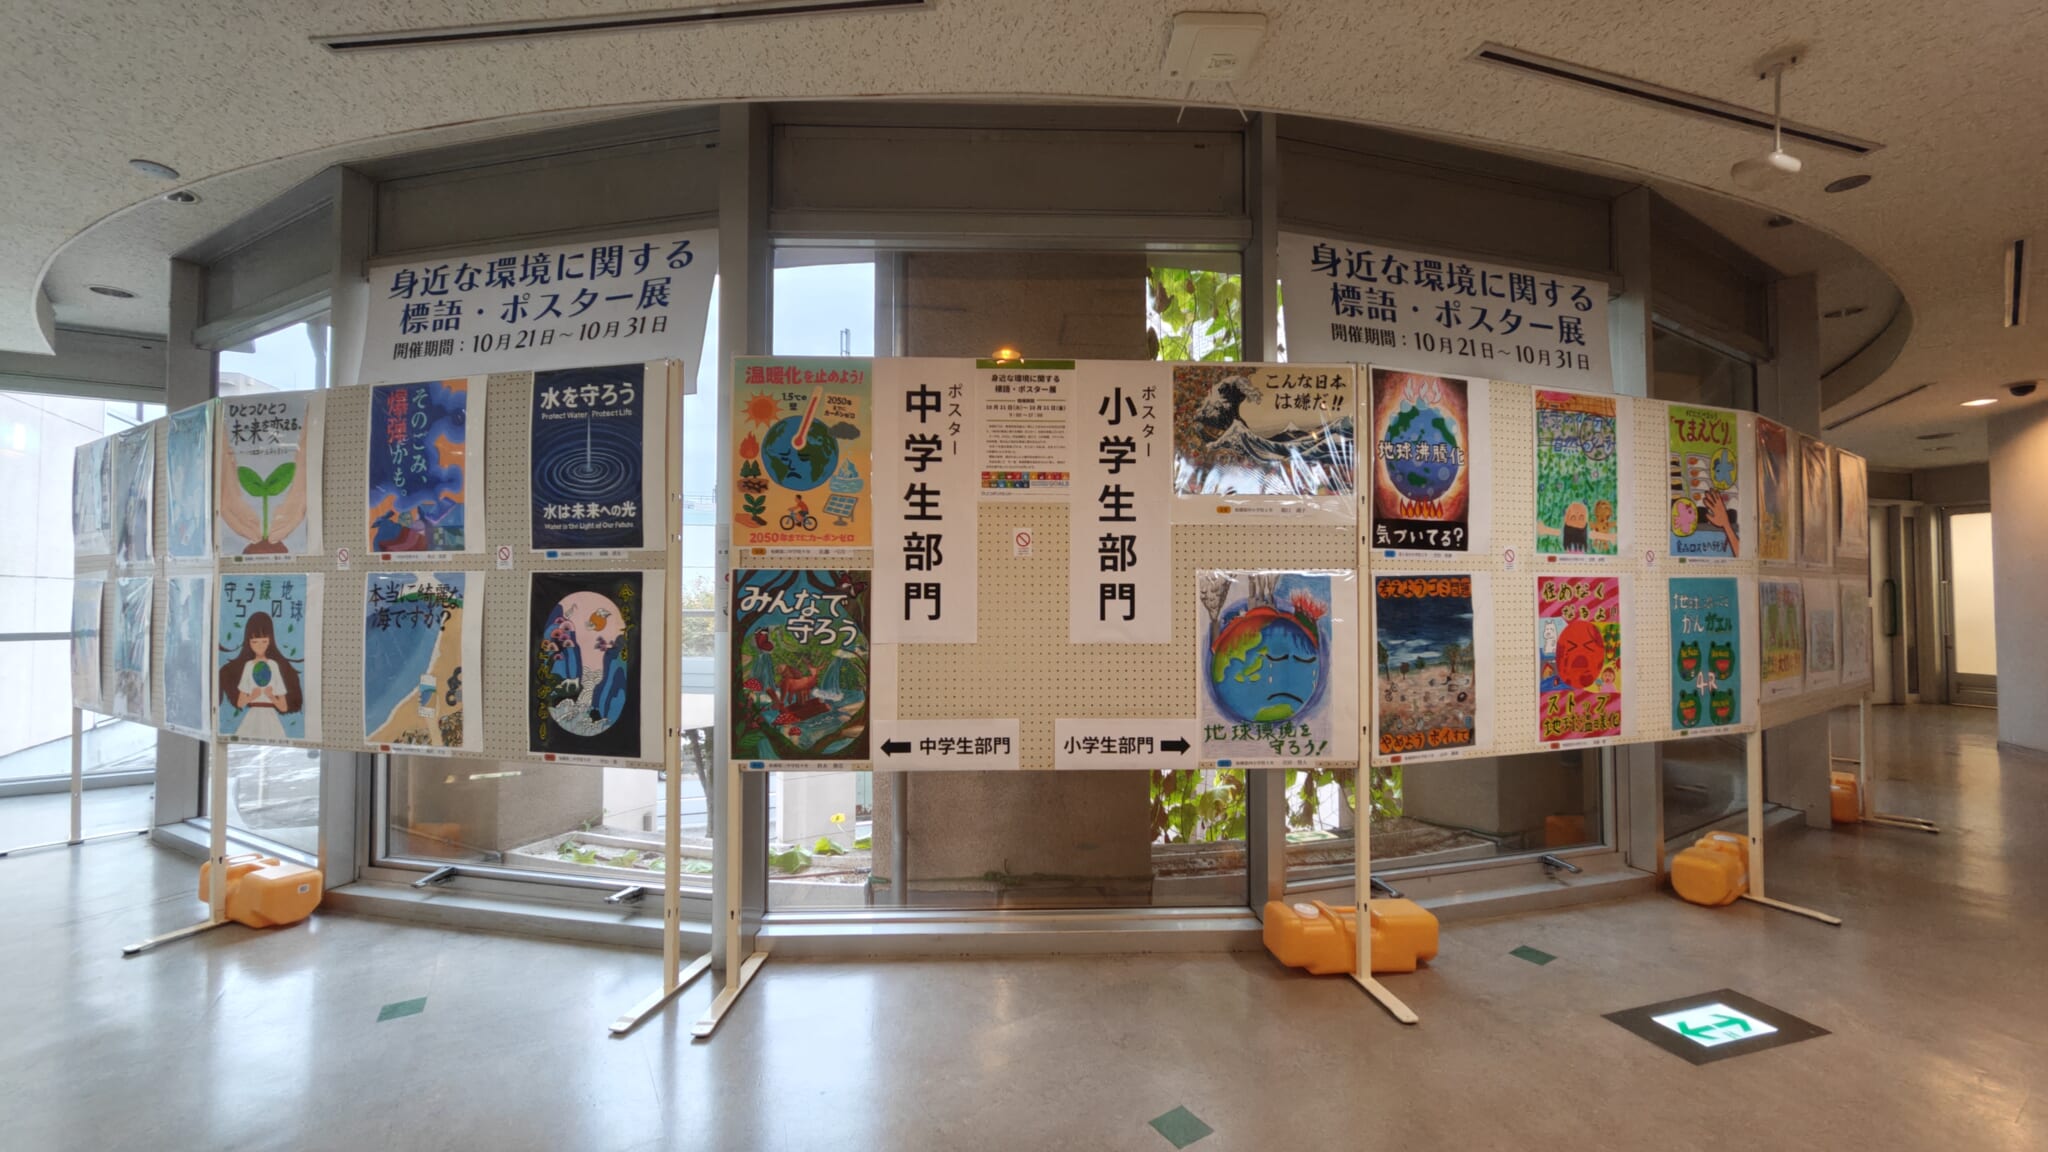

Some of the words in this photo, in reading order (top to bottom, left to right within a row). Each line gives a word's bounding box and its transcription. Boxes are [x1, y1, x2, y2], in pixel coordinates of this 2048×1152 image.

[388, 239, 695, 299] 身近な環境に関する
[1311, 243, 1593, 312] 身近な環境に関する
[399, 277, 673, 335] 標語・ポスター展
[1330, 282, 1586, 346] 標語・ポスター展
[541, 382, 635, 409] 水を守ろう
[1266, 374, 1347, 390] こんな日本
[229, 403, 287, 417] ひとつひとつ
[948, 384, 963, 456] ポスター
[1142, 386, 1157, 458] ポスター
[543, 501, 637, 520] 水は未来への光
[903, 384, 943, 621] 中学生部門
[1098, 387, 1138, 621] 小学生部門
[740, 586, 848, 618] みんなで
[786, 616, 858, 647] 守ろう
[919, 736, 1011, 755] 中学生部門
[1063, 735, 1155, 755] 小学生部門
[1204, 724, 1312, 742] 地球環境を
